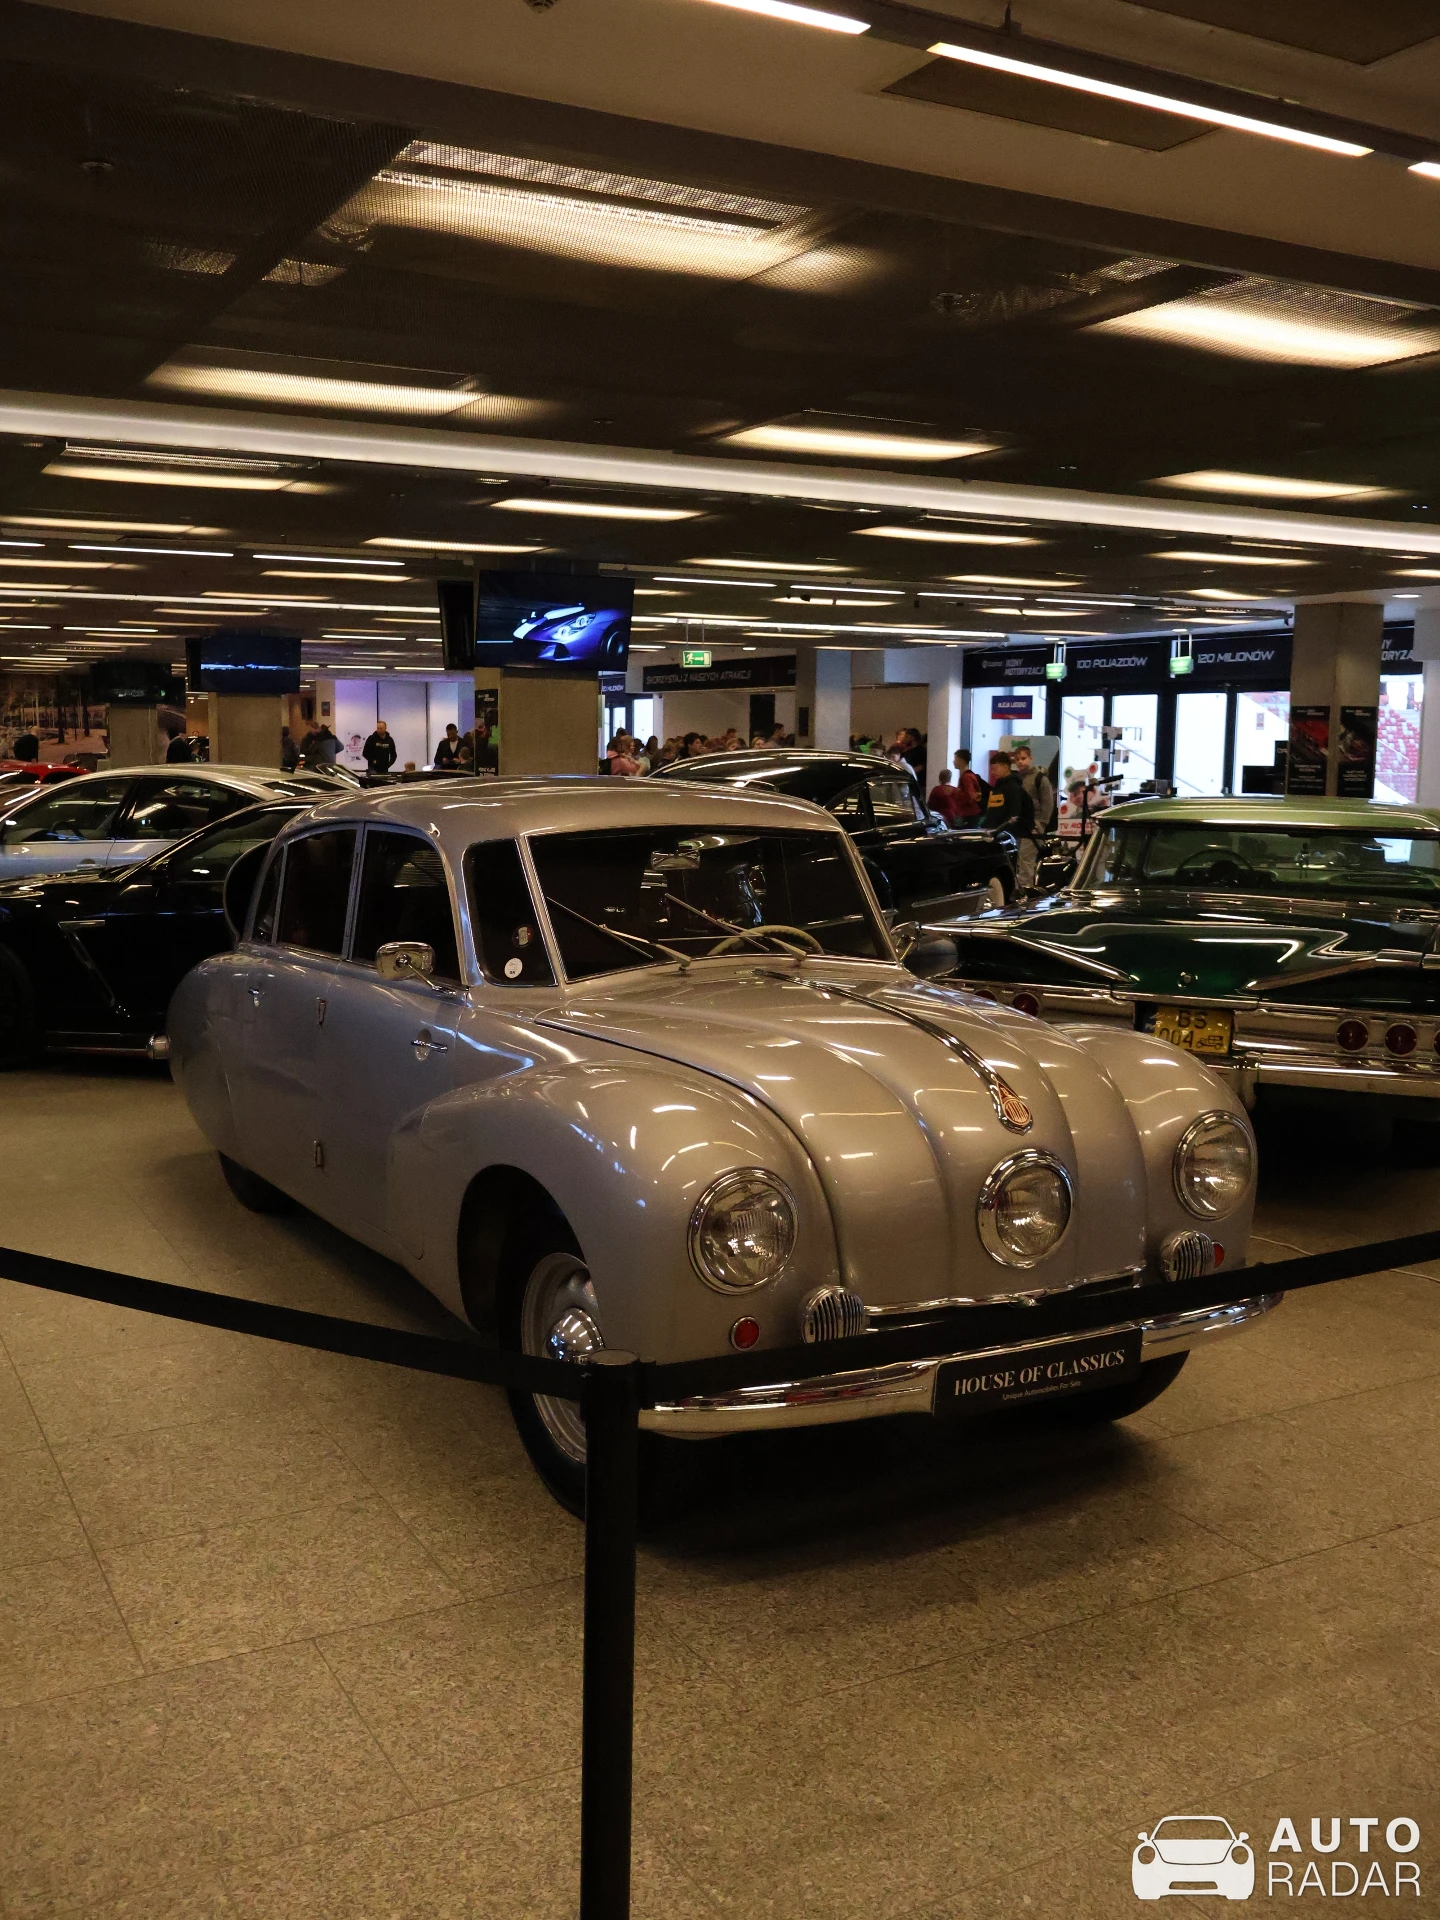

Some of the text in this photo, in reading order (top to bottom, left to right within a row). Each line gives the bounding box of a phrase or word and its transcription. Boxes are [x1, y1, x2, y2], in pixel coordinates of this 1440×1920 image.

[1077, 656, 1148, 669] 100 POJAZDÓW
[1197, 649, 1275, 663] 120 MILIONÓW
[1178, 1010, 1208, 1029] BS
[954, 1350, 1125, 1396] HOUSE OF CLASSICS
[1002, 1392, 1023, 1401] Unique
[1070, 1380, 1081, 1388] Sale
